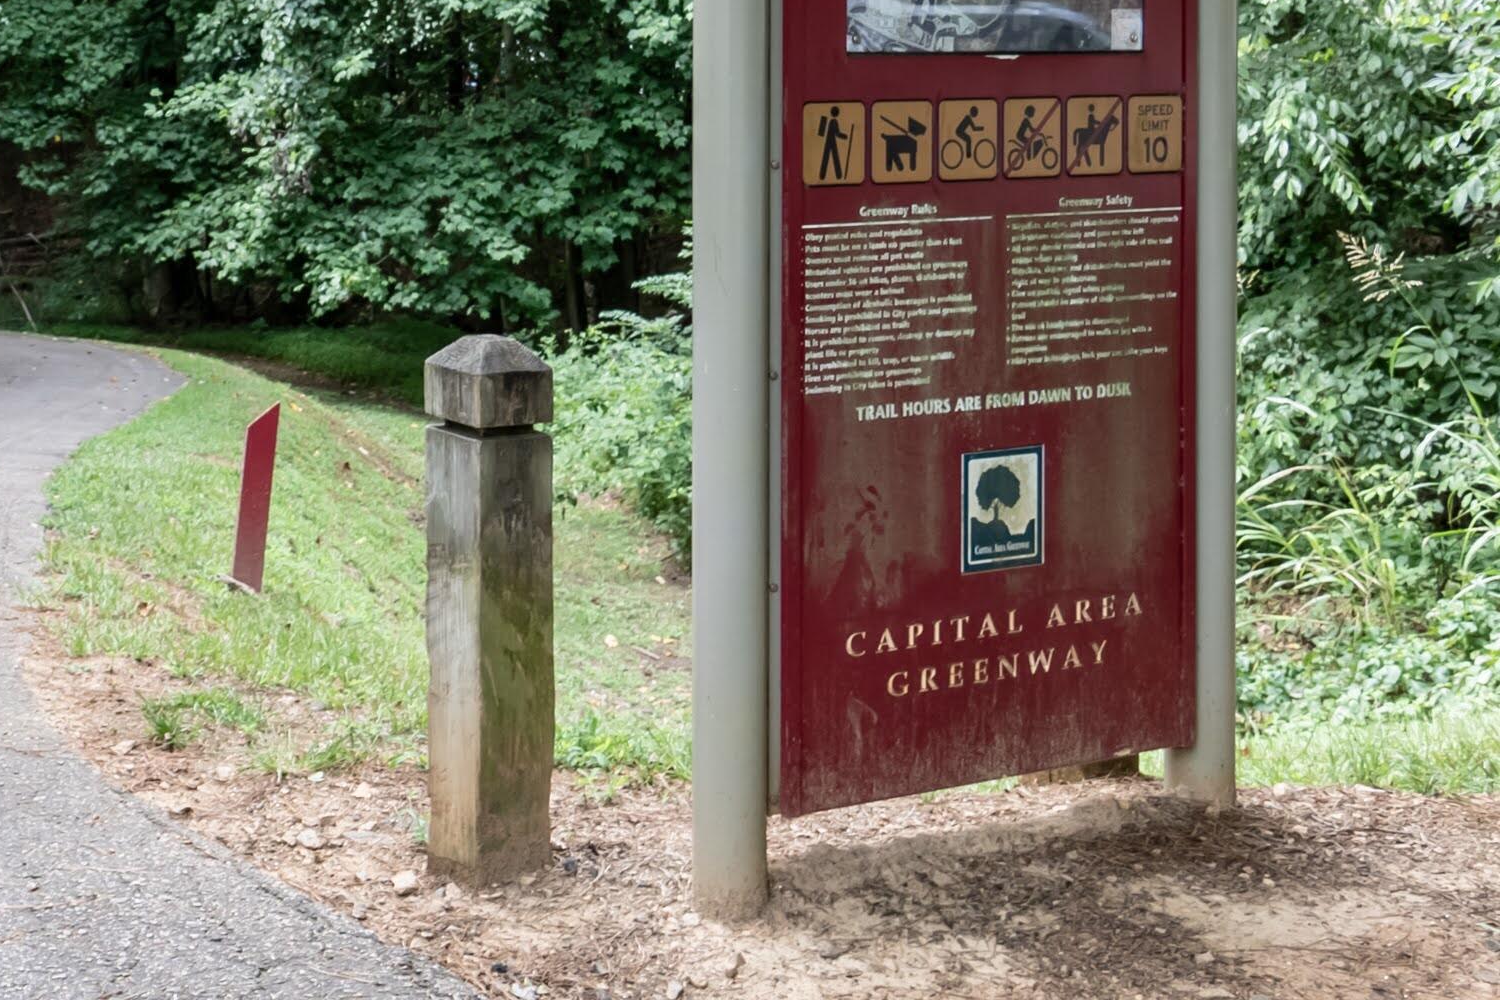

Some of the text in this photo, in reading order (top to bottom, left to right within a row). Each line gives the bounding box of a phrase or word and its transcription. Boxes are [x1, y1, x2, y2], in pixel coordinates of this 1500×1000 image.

[1138, 104, 1173, 116] SPEED
[1141, 120, 1169, 132] LIMIT
[1143, 136, 1168, 163] 10
[859, 203, 938, 218] Greenway Rules
[1059, 194, 1133, 208] Greenway Safety
[856, 382, 1132, 421] TRAIL HOURS ARE FROM DAWN TO DUSK
[845, 592, 1143, 658] CAPITAL AREA
[887, 639, 1107, 698] GREENWAY
